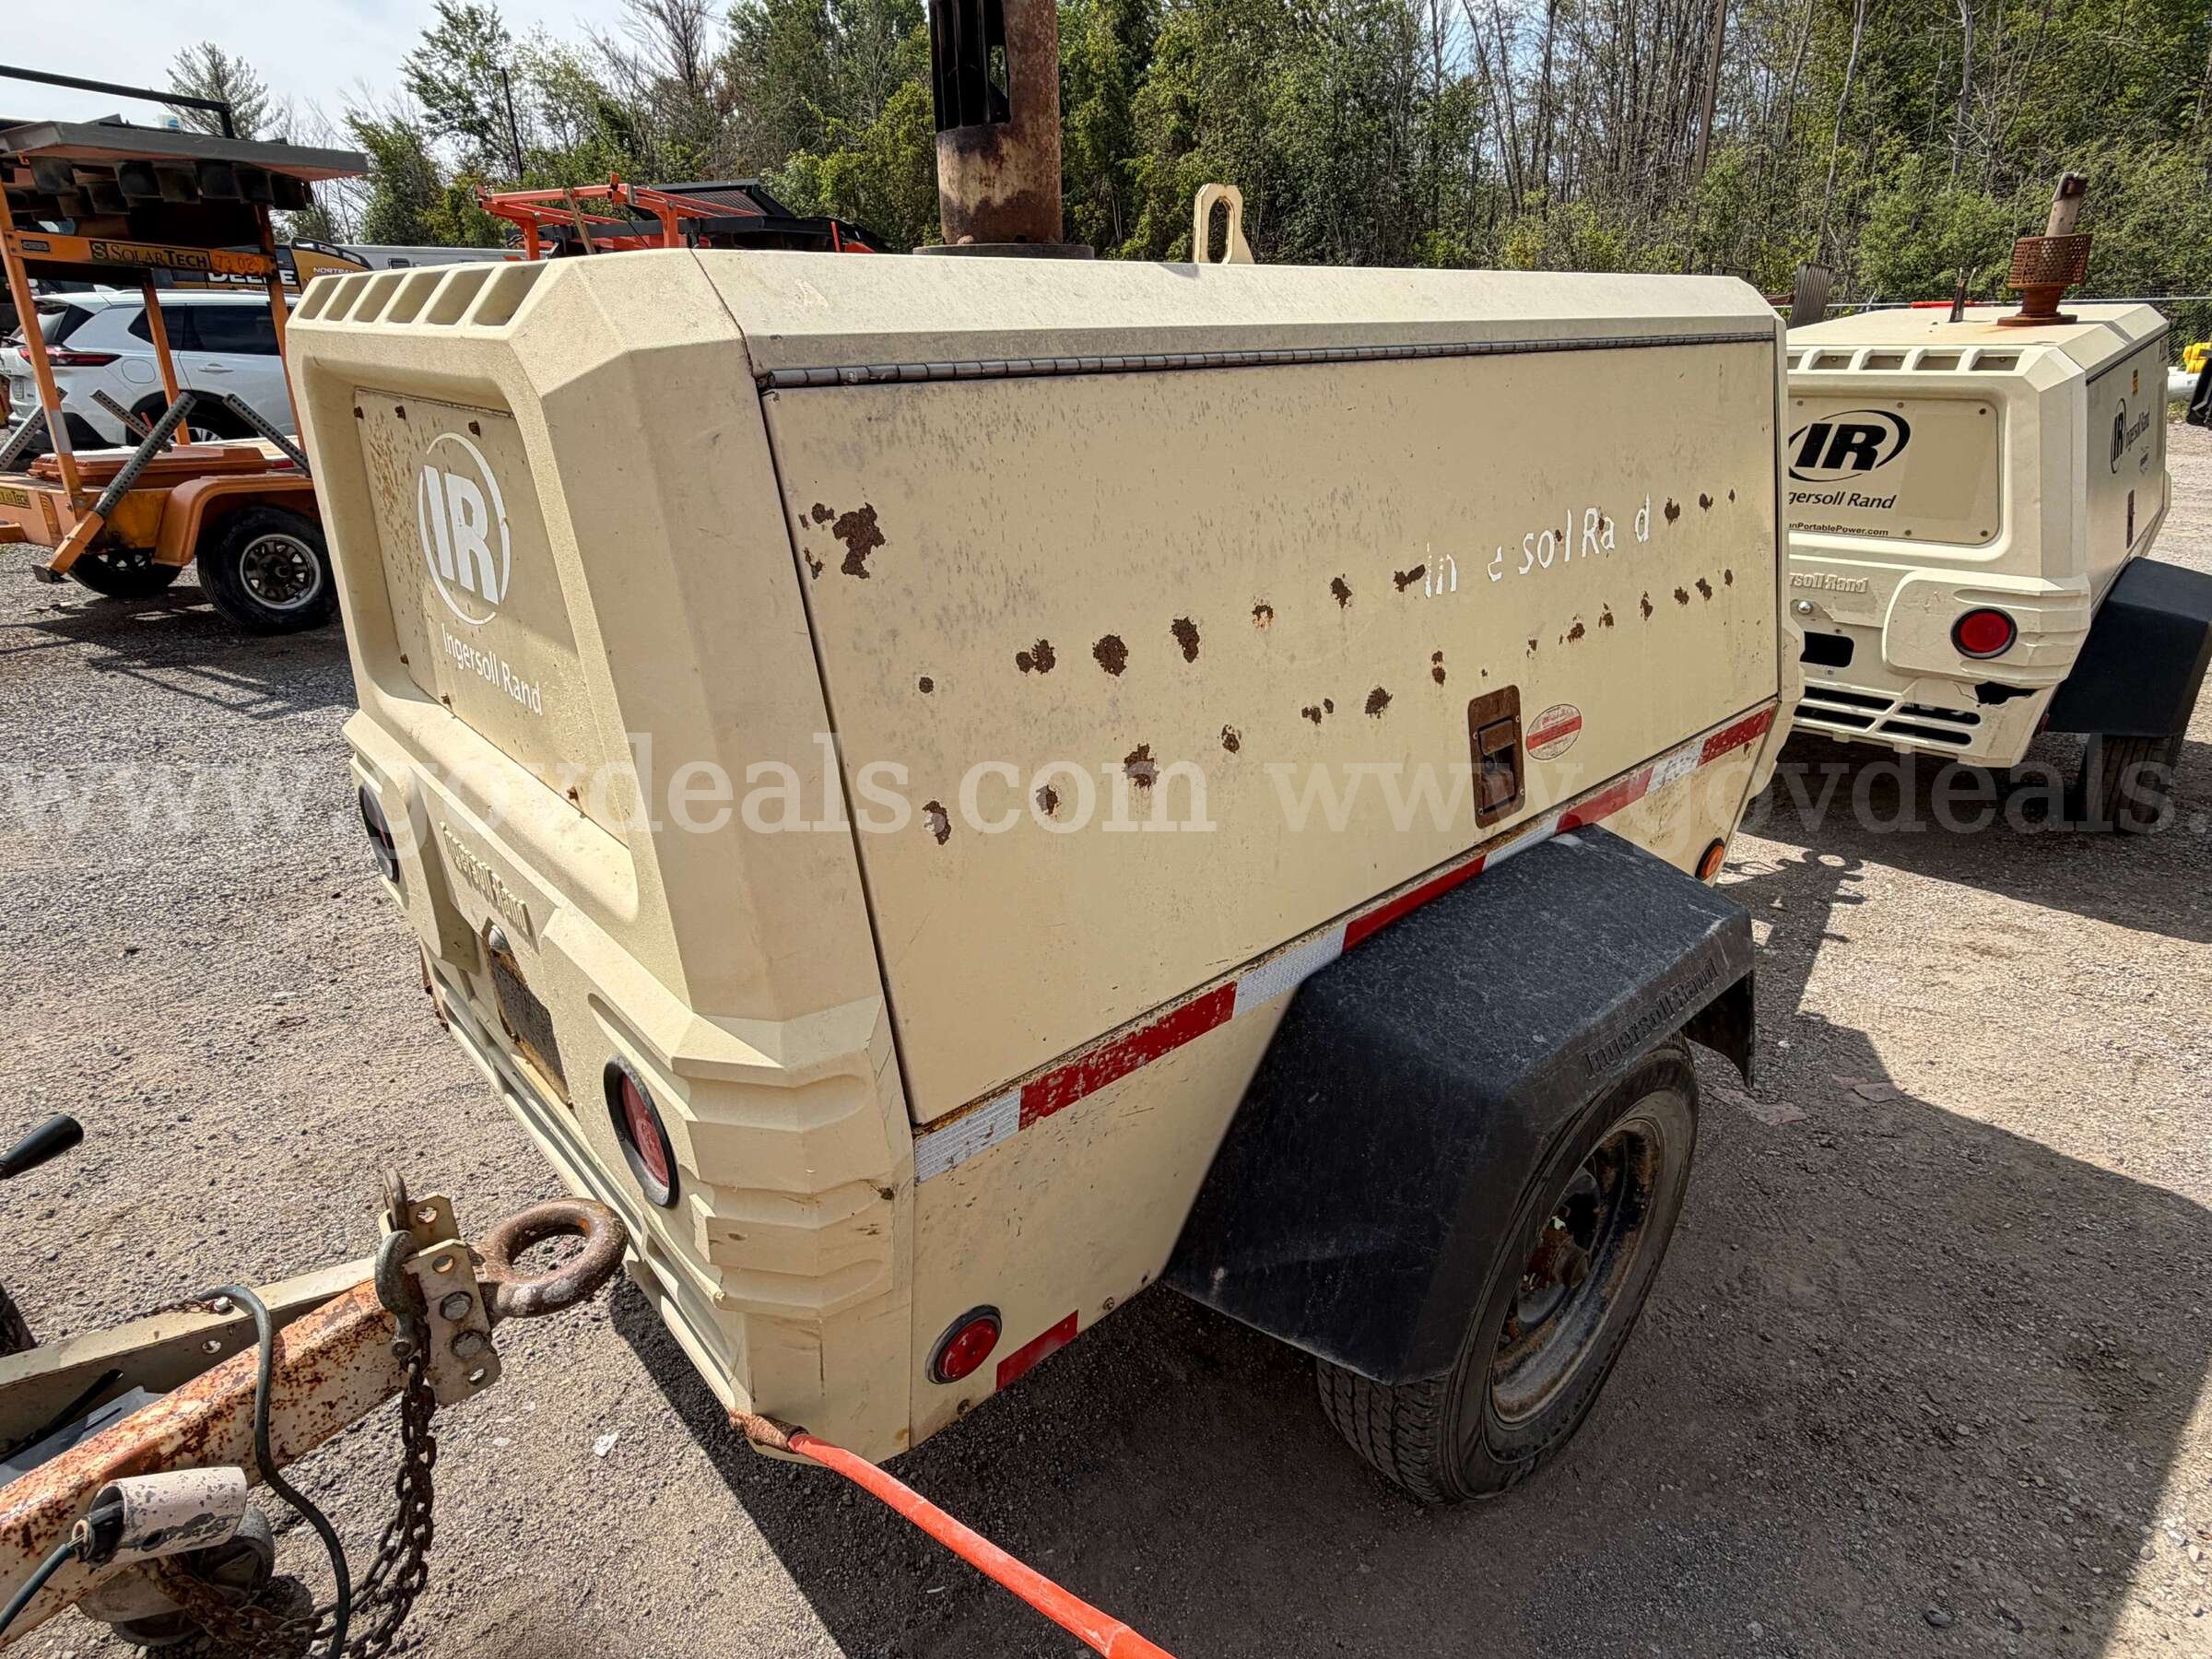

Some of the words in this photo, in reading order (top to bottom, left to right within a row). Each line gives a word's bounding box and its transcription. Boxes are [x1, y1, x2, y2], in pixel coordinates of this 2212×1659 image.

[1795, 423, 1887, 471] IR
[424, 465, 499, 605] IR
[1847, 493, 1897, 509] Rand
[441, 623, 500, 688] Ingersoll
[501, 660, 542, 715] Rand
